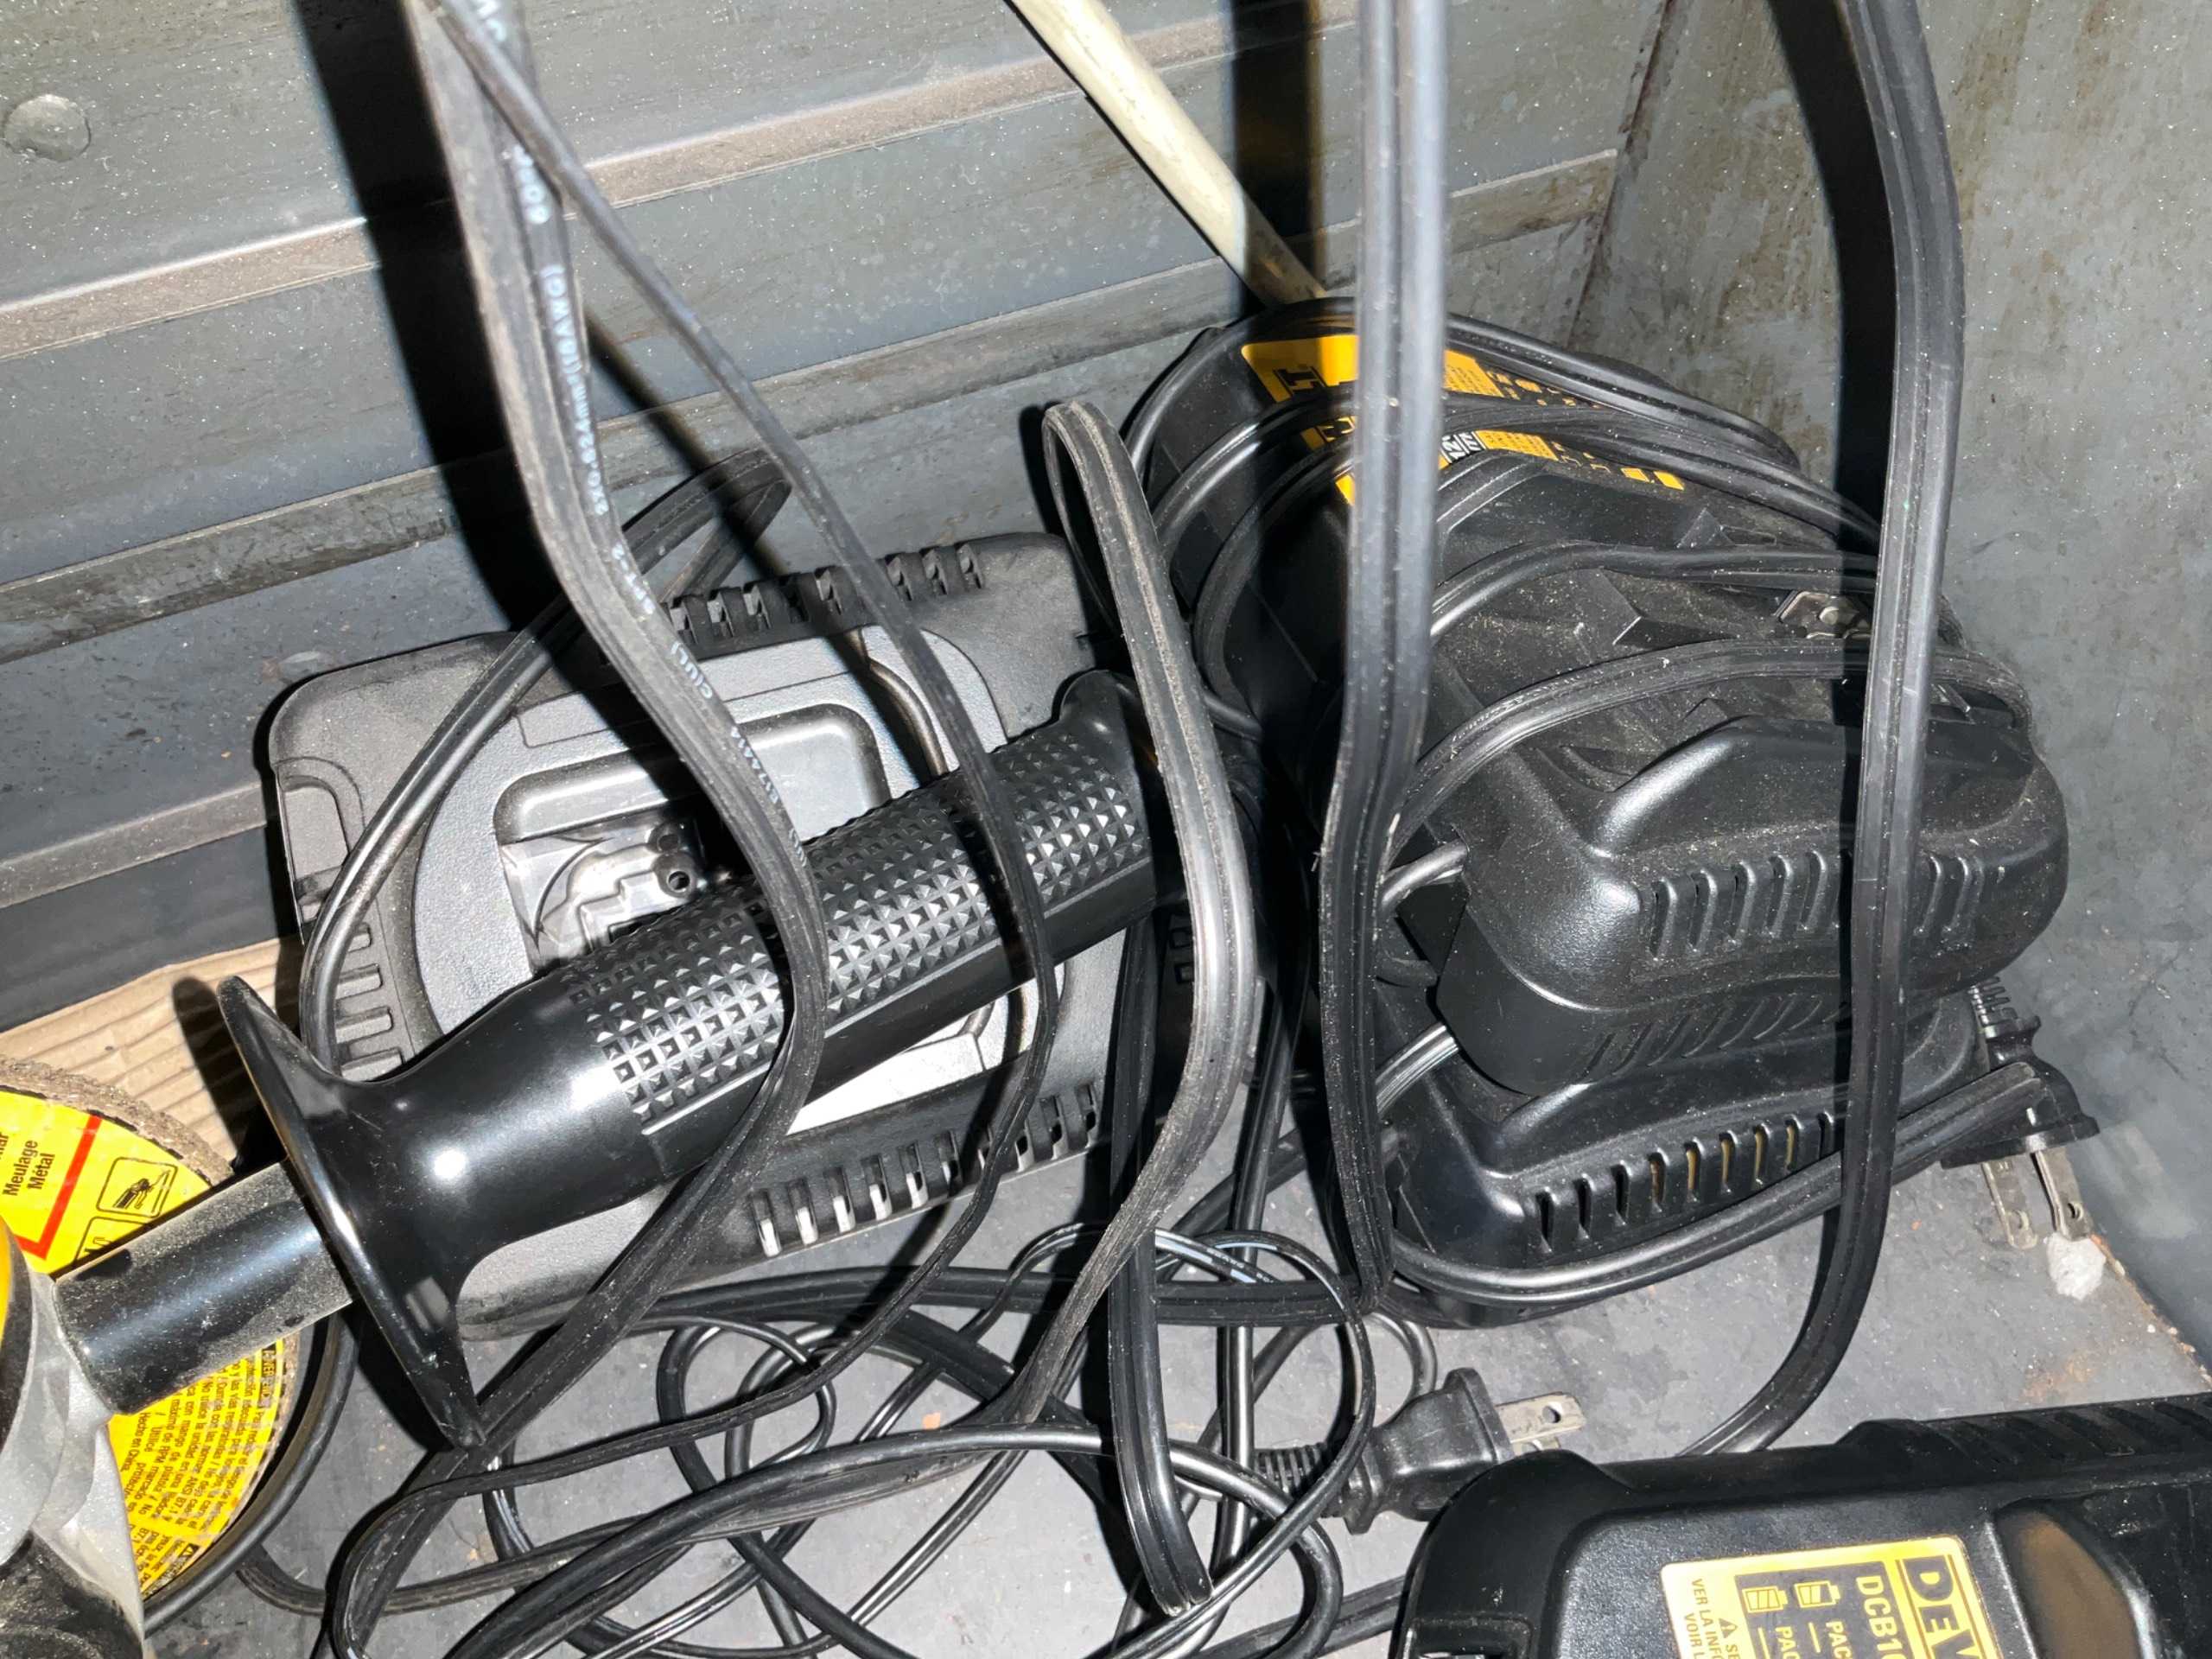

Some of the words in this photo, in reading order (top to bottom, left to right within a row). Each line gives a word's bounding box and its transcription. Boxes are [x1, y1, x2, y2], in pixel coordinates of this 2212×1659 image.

[2, 1140, 38, 1197] Meulage
[27, 1152, 56, 1190] Métal
[183, 1401, 195, 1416] con
[213, 1382, 228, 1412] Cumla
[134, 1411, 151, 1438] Hecho
[165, 1398, 181, 1431] máximo
[130, 1437, 142, 1449] en
[143, 1427, 162, 1453] Utilice
[162, 1431, 174, 1443] de
[174, 1420, 191, 1448] mango
[154, 1445, 171, 1465] RPM
[168, 1451, 181, 1462] de
[191, 1445, 211, 1474] norma
[134, 1465, 160, 1501] marcado
[153, 1465, 174, 1493] pistola
[137, 1503, 154, 1516] No
[1691, 1578, 1708, 1605] VER
[1684, 1613, 1703, 1651] VOIR
[1699, 1609, 1714, 1629] LA
[1825, 1620, 1853, 1659] PAC
